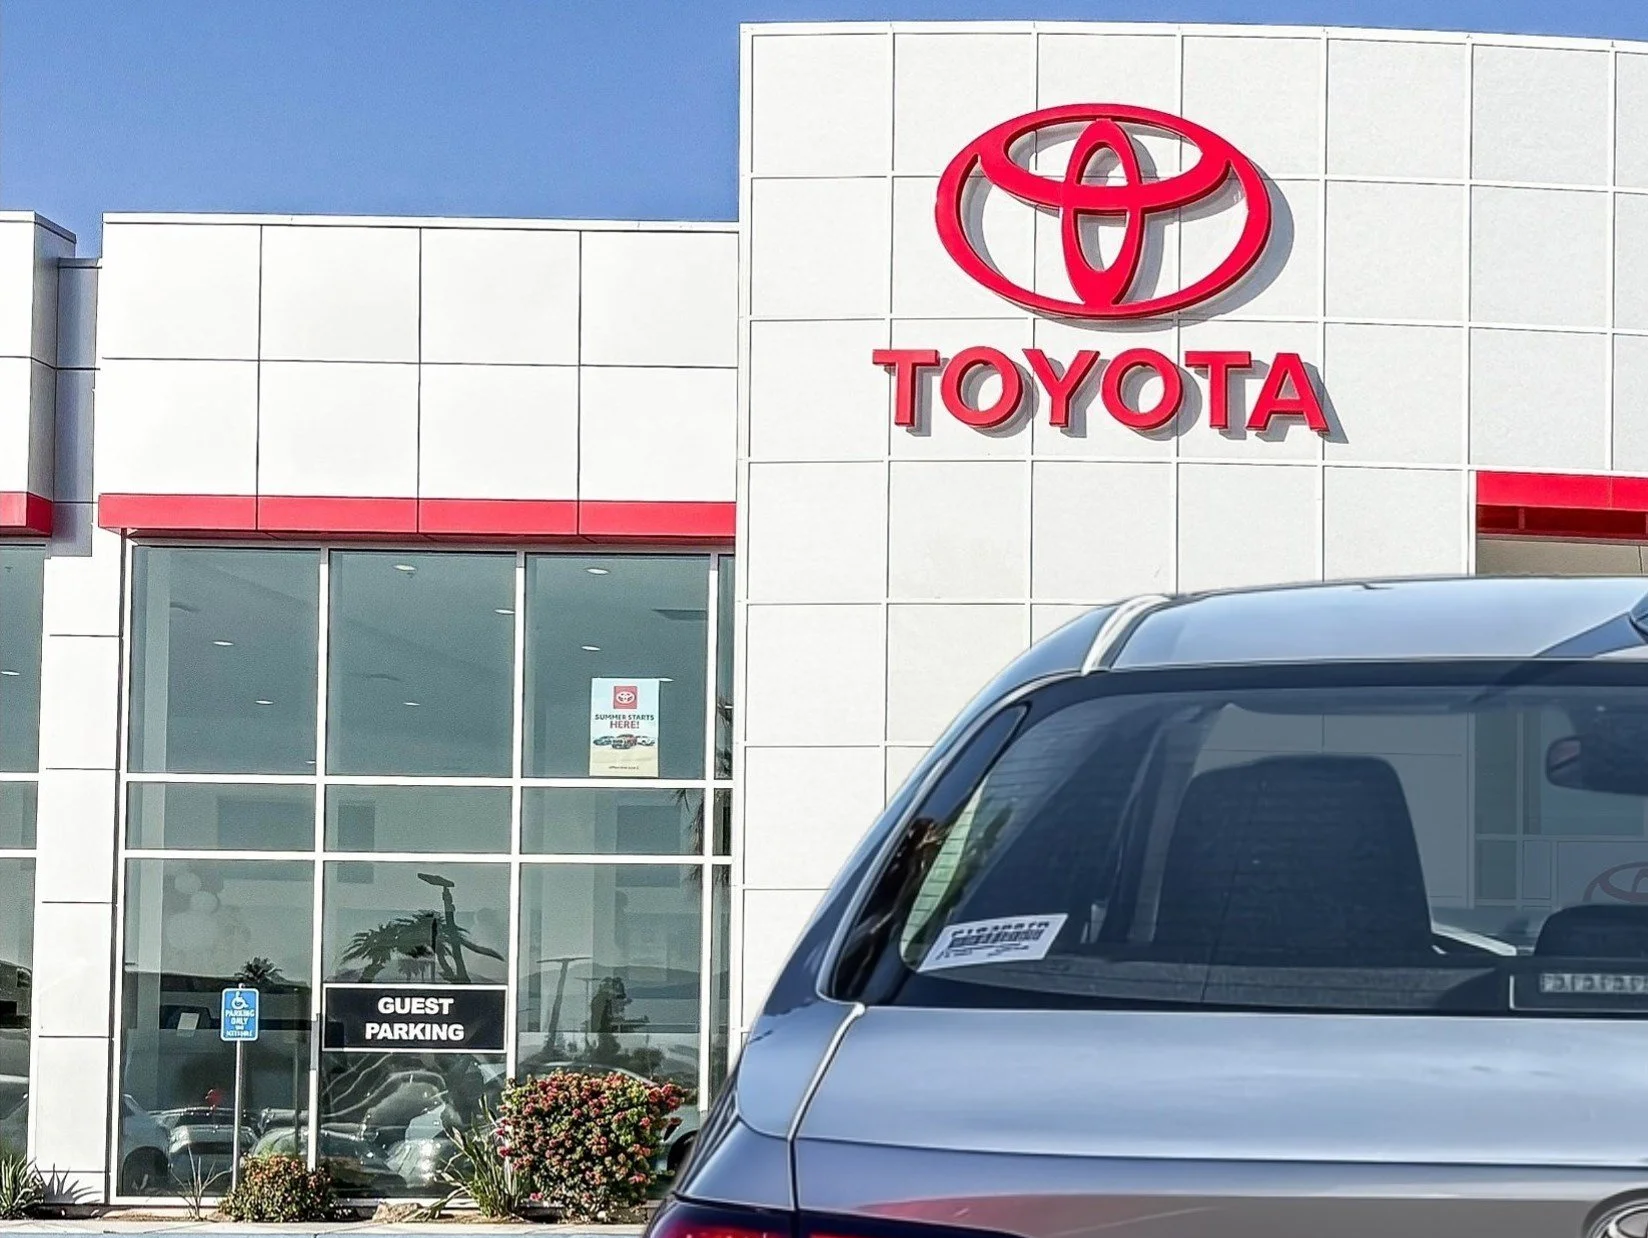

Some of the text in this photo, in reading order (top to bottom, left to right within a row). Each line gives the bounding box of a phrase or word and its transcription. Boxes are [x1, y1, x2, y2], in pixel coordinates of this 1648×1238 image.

[872, 346, 1331, 433] TOYOTA
[610, 721, 640, 729] HERE!
[377, 996, 454, 1015] GUEST
[225, 1009, 255, 1017] PARKING
[231, 1017, 248, 1025] ONLY
[365, 1022, 465, 1041] PARKING
